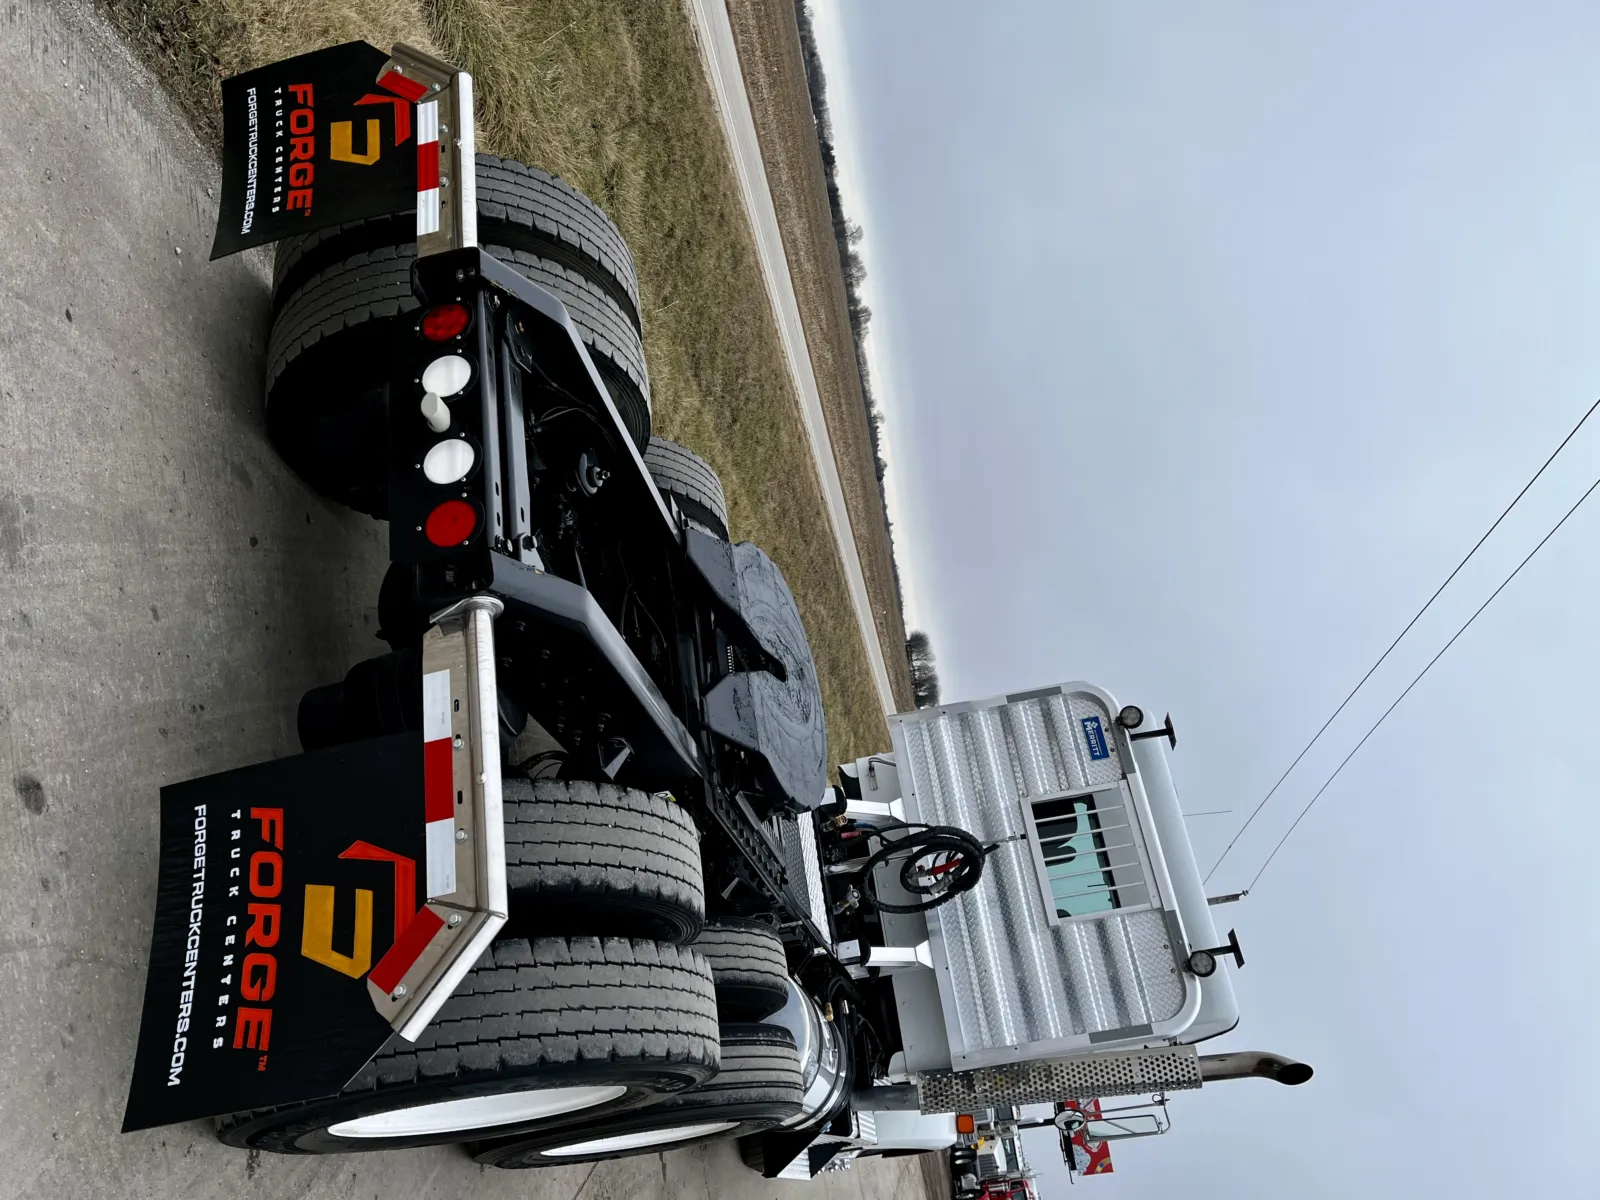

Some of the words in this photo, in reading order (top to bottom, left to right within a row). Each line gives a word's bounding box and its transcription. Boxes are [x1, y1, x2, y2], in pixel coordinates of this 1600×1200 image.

[241, 87, 257, 235] FORGETRUCKCENTERS.COM
[274, 87, 283, 138] TRUCK
[287, 83, 315, 211] FORGE
[272, 146, 283, 213] CENTERS
[1084, 721, 1100, 756] MERRITT
[229, 809, 240, 897] TRUCK
[168, 803, 207, 1087] FORGETRUCKCENTERS.COM
[213, 915, 236, 1049] CENTERS
[233, 807, 284, 1051] FORGE
